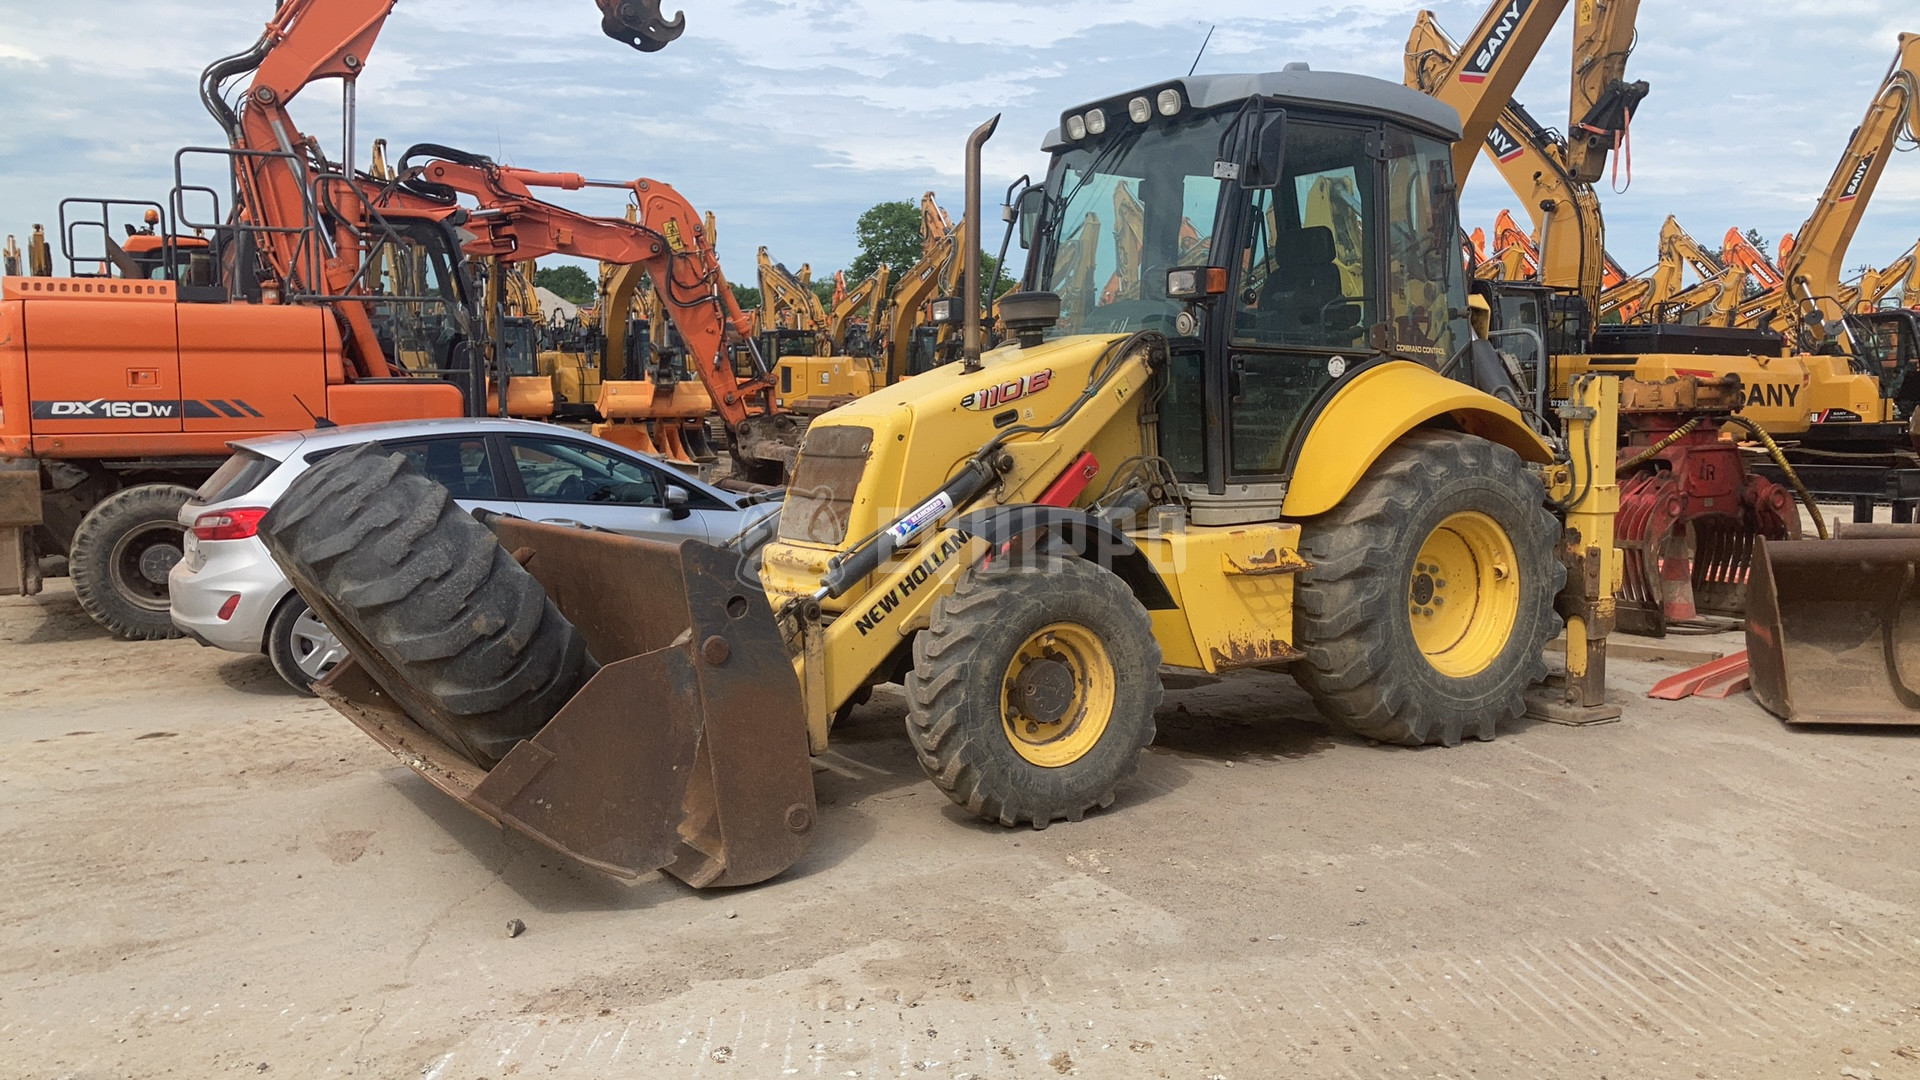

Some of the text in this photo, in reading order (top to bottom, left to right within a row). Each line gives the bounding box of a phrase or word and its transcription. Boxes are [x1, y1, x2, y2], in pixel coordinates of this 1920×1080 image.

[1476, 0, 1520, 71] SANY
[1488, 127, 1512, 153] NY
[1847, 161, 1867, 195] SANY
[1396, 344, 1446, 355] COMMAND CONTROL
[854, 589, 900, 636] NEW
